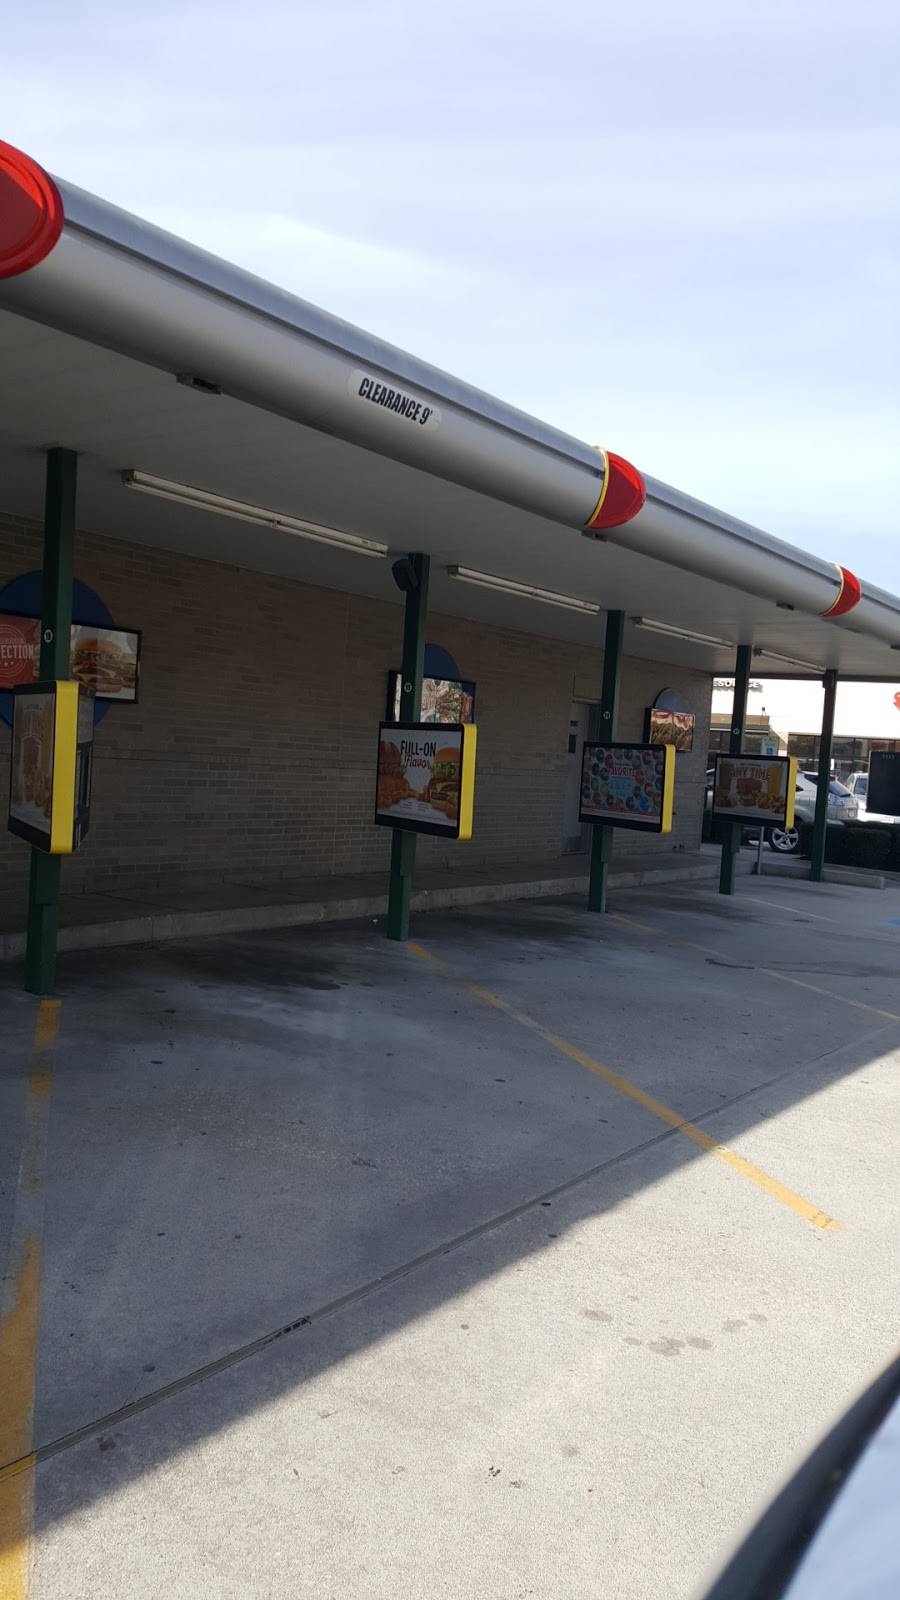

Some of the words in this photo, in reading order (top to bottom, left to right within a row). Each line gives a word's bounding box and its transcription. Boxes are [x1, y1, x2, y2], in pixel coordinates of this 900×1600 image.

[358, 377, 422, 421] CLEARANCE
[419, 407, 434, 425] 9'
[0, 644, 34, 660] ECTION
[400, 740, 437, 757] FULL-ON
